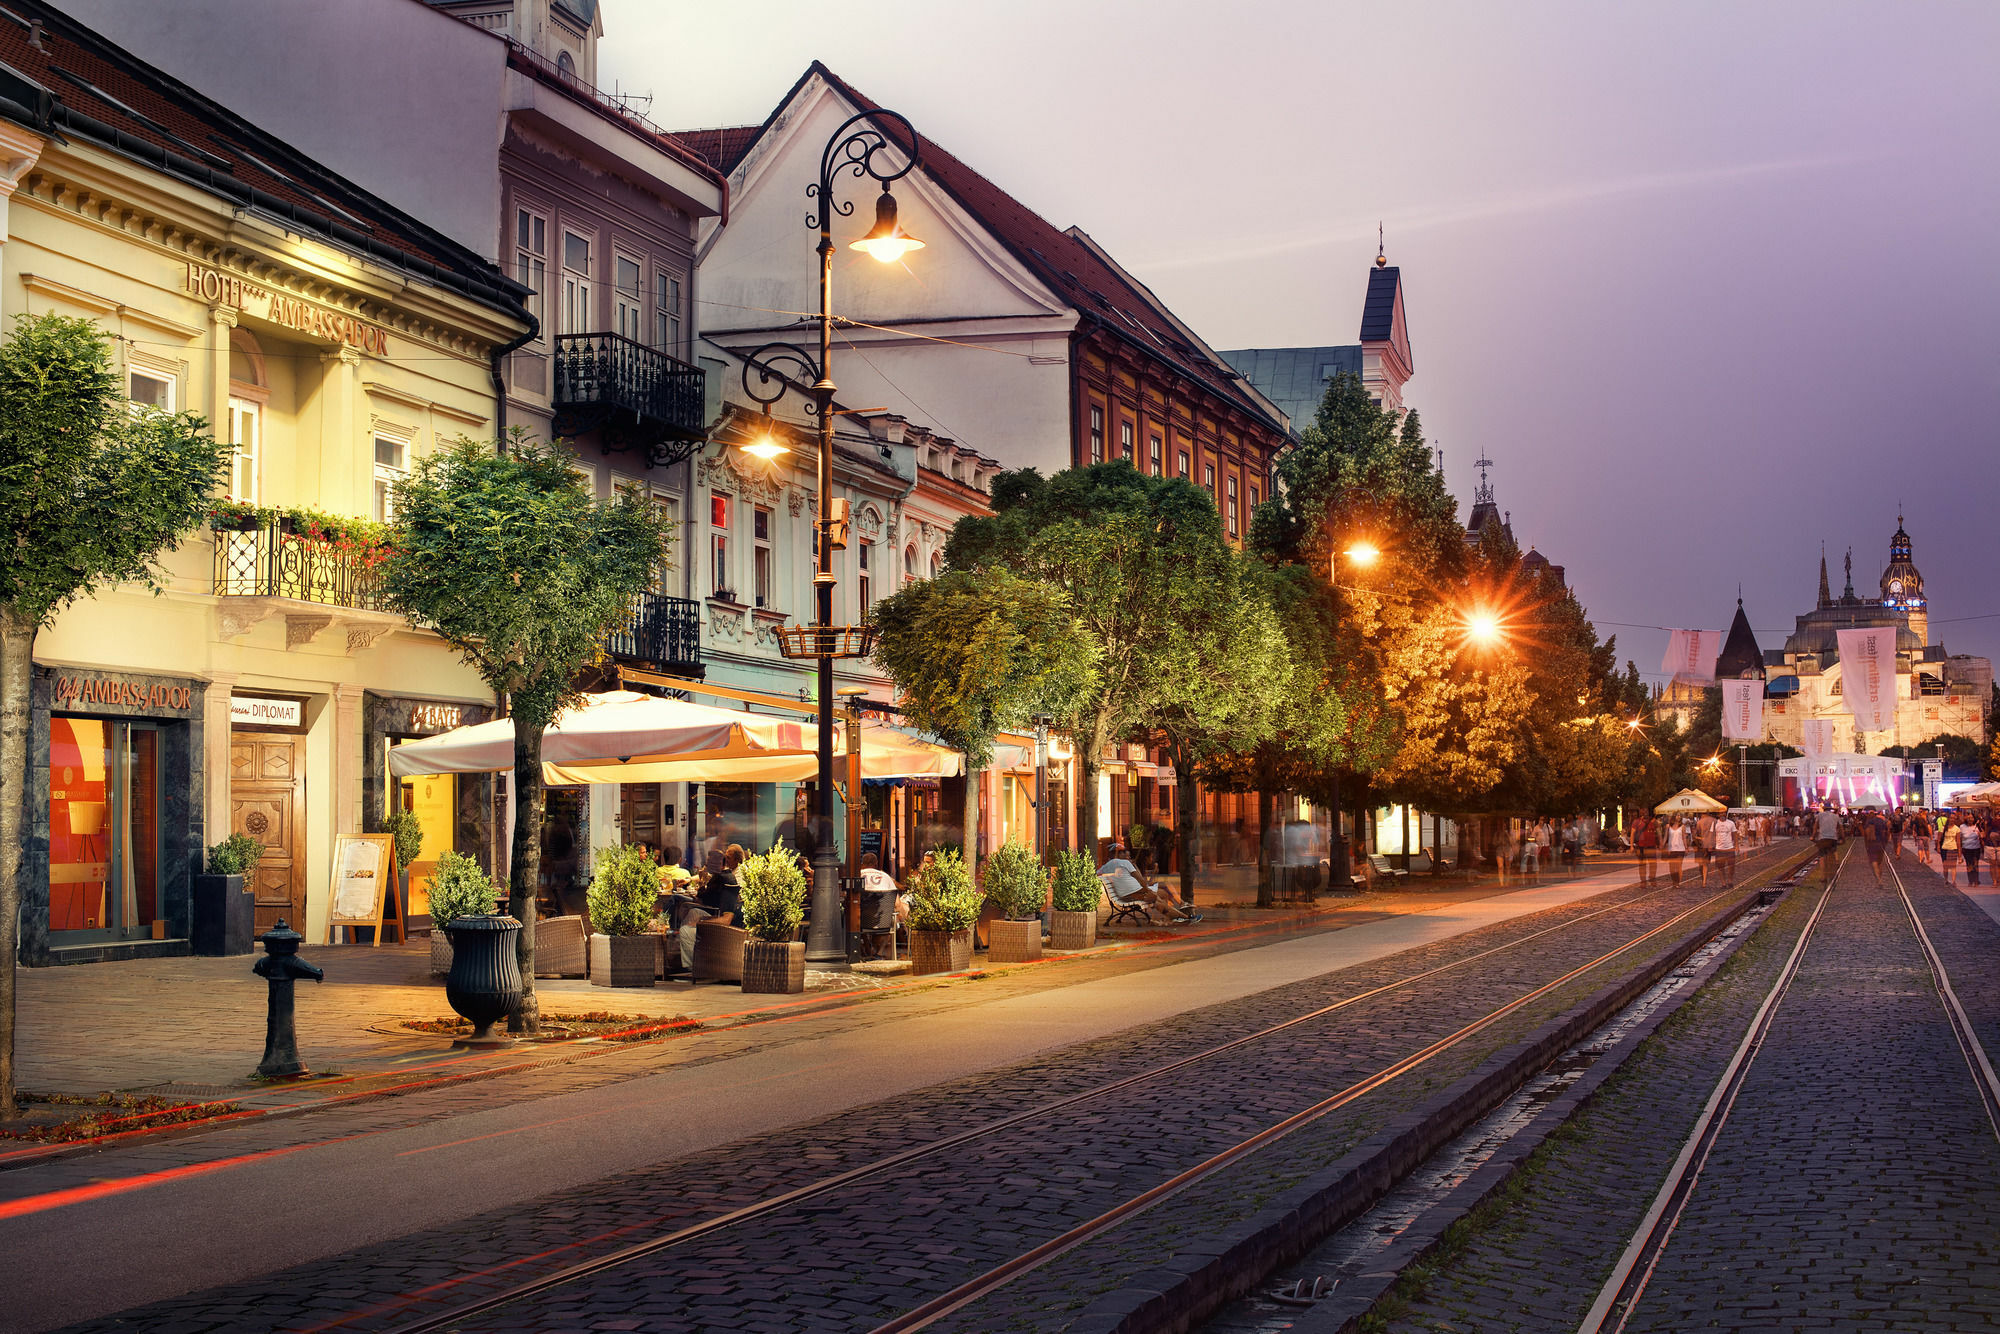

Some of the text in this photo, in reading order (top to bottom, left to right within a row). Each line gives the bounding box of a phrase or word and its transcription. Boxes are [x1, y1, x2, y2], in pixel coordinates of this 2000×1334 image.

[185, 263, 389, 356] HOTEL AMBASSADOR
[81, 679, 191, 710] AMBASSADOR
[252, 703, 295, 720] DIPLOMAT
[428, 706, 462, 728] BAYER
